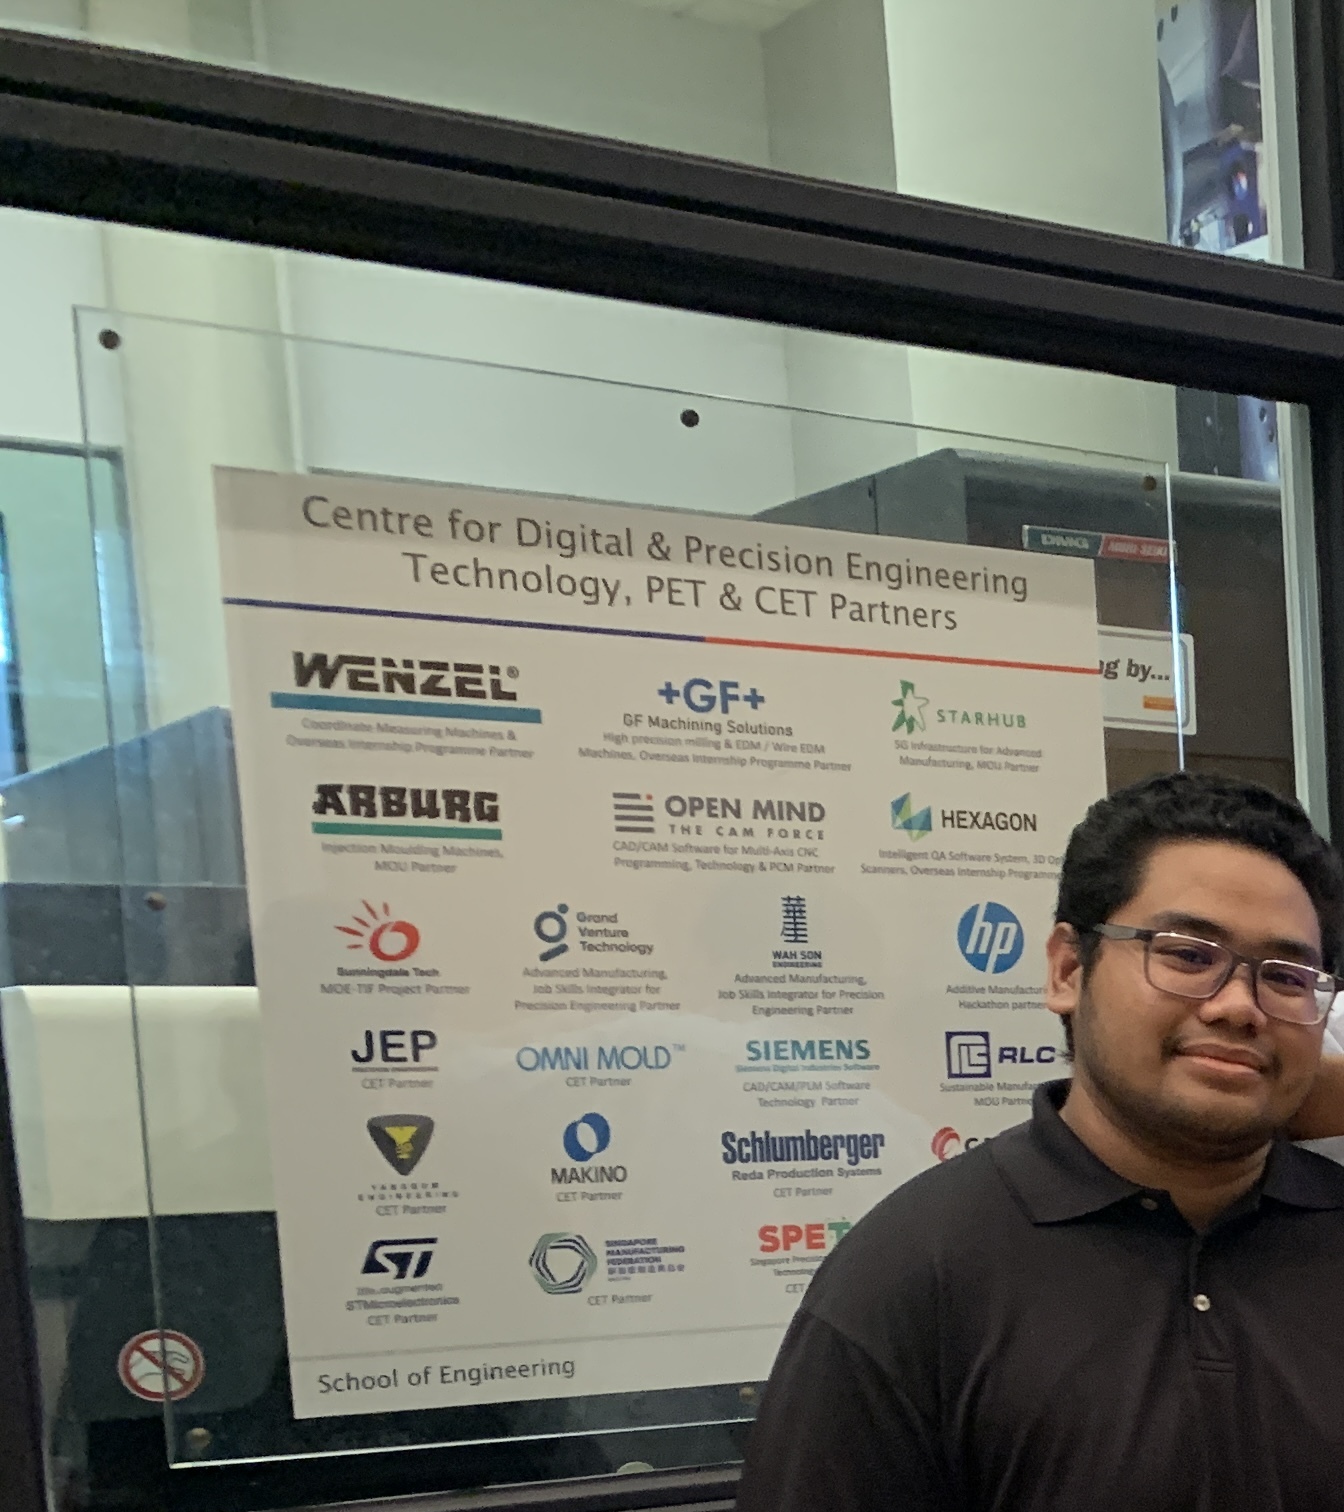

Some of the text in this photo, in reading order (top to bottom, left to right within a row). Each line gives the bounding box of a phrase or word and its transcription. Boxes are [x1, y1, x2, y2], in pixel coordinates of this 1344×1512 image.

[302, 495, 1029, 602] Centre for Digital & Precision Engineering
[402, 552, 958, 631] Technology, PET & CET Partners
[624, 713, 793, 737] GF Machining Solutions
[937, 709, 1026, 728] STARHUB
[603, 732, 628, 744] High
[631, 735, 682, 748] precision
[735, 740, 761, 751] EDM
[772, 742, 797, 753] Wire
[801, 743, 825, 754] EDM
[640, 751, 689, 763] Overseas
[814, 760, 851, 771] Partner
[312, 783, 499, 823] ARBURG
[665, 795, 825, 822] OPEN MIND
[942, 809, 1037, 832] HEXAGON
[670, 824, 824, 840] THE CAM FORCE
[672, 842, 721, 855] Software
[723, 844, 738, 855] for
[949, 852, 991, 862] Software
[797, 863, 835, 874] Partner
[577, 912, 618, 923] Grand
[578, 927, 628, 937] Venture
[966, 901, 1018, 973] hp
[580, 941, 654, 955] Technology
[773, 951, 822, 959] WAH SON
[734, 974, 786, 983] Advanced
[718, 991, 736, 999] Job
[822, 990, 836, 999] for
[947, 985, 985, 994] Additive
[752, 1005, 853, 1017] Engineering Partner
[959, 1001, 1009, 1010] Hackathon
[351, 1030, 438, 1063] JEP
[746, 1039, 870, 1061] SIEMENS
[516, 1047, 588, 1071] OMNI
[998, 1047, 1055, 1063] RLC
[590, 1077, 631, 1086] Partner
[826, 1081, 870, 1090] Software
[822, 1097, 859, 1106] Partner
[722, 1129, 885, 1166] Schlumberger
[551, 1166, 627, 1184] MAKINO
[732, 1167, 882, 1181] Reda Production Systems
[773, 1187, 833, 1197] CET Partner
[361, 1237, 438, 1280] ST
[318, 1358, 576, 1394] School of Engineering
